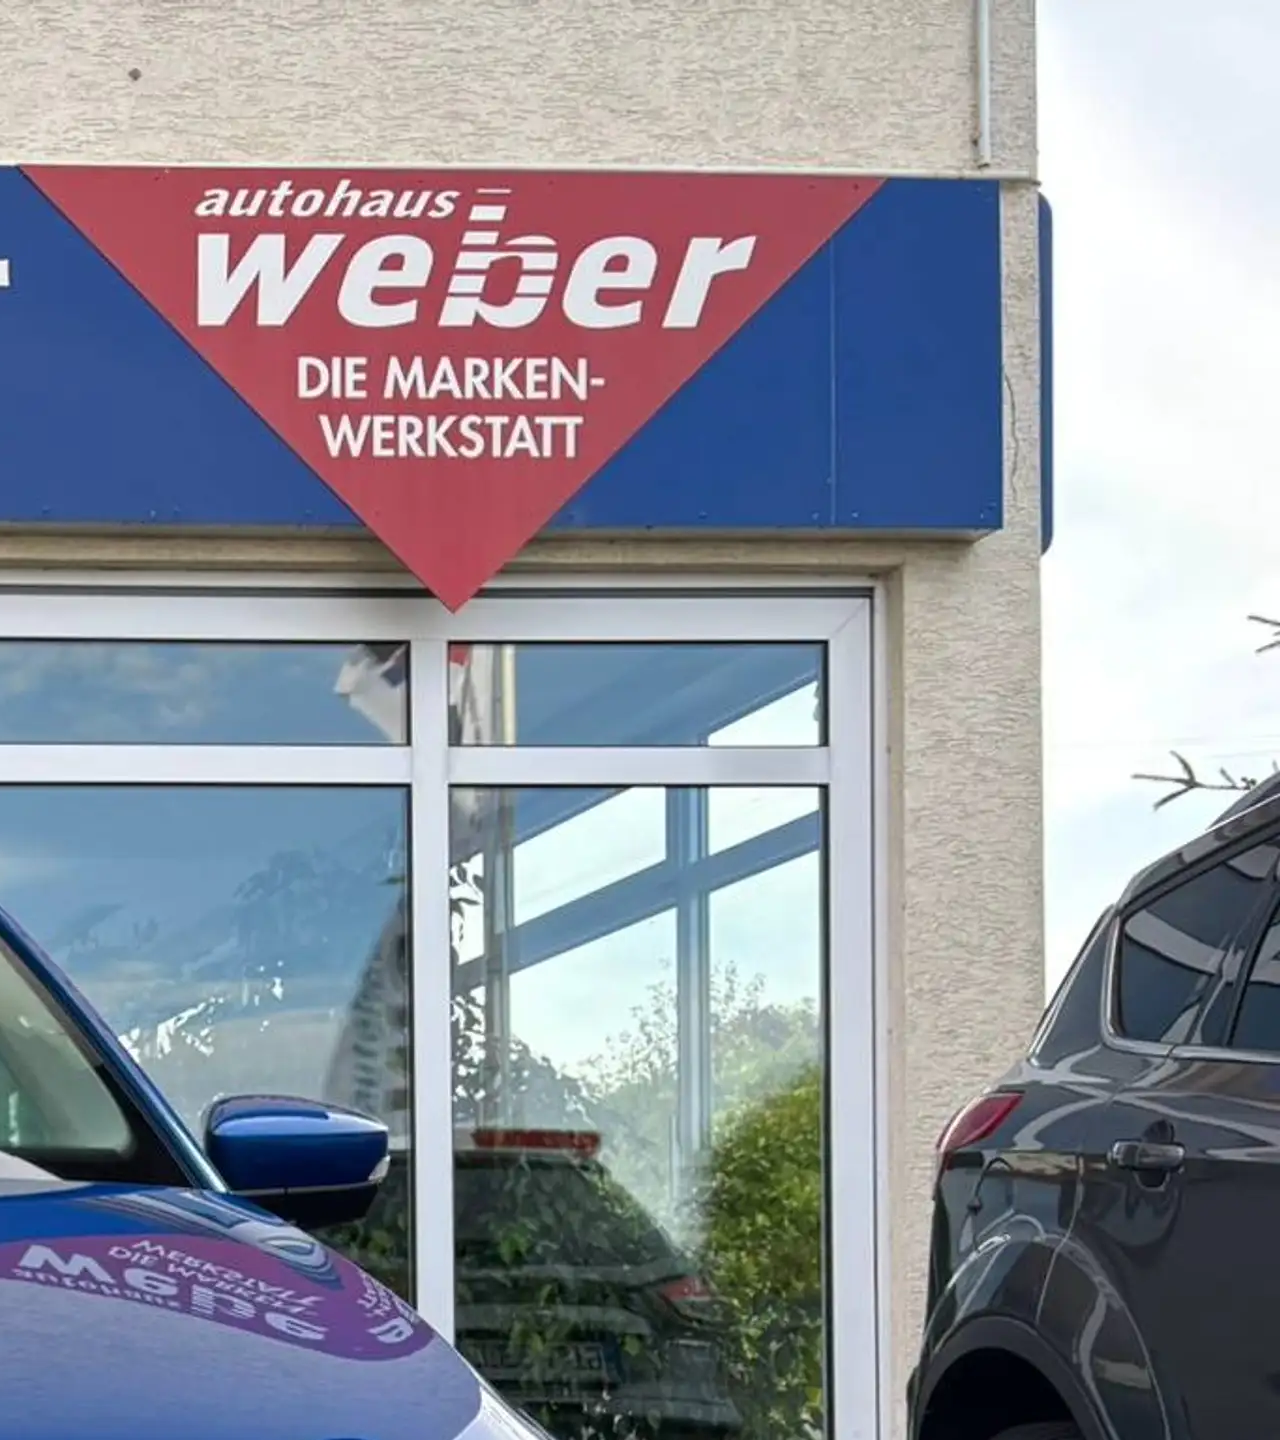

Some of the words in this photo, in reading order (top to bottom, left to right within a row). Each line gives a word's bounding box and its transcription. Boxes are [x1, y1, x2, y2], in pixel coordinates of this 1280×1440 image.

[194, 180, 461, 219] autohaus
[195, 188, 758, 330] weber
[297, 355, 368, 400] DIE
[382, 355, 606, 401] MARKEN-
[318, 414, 585, 460] WERKSTATT
